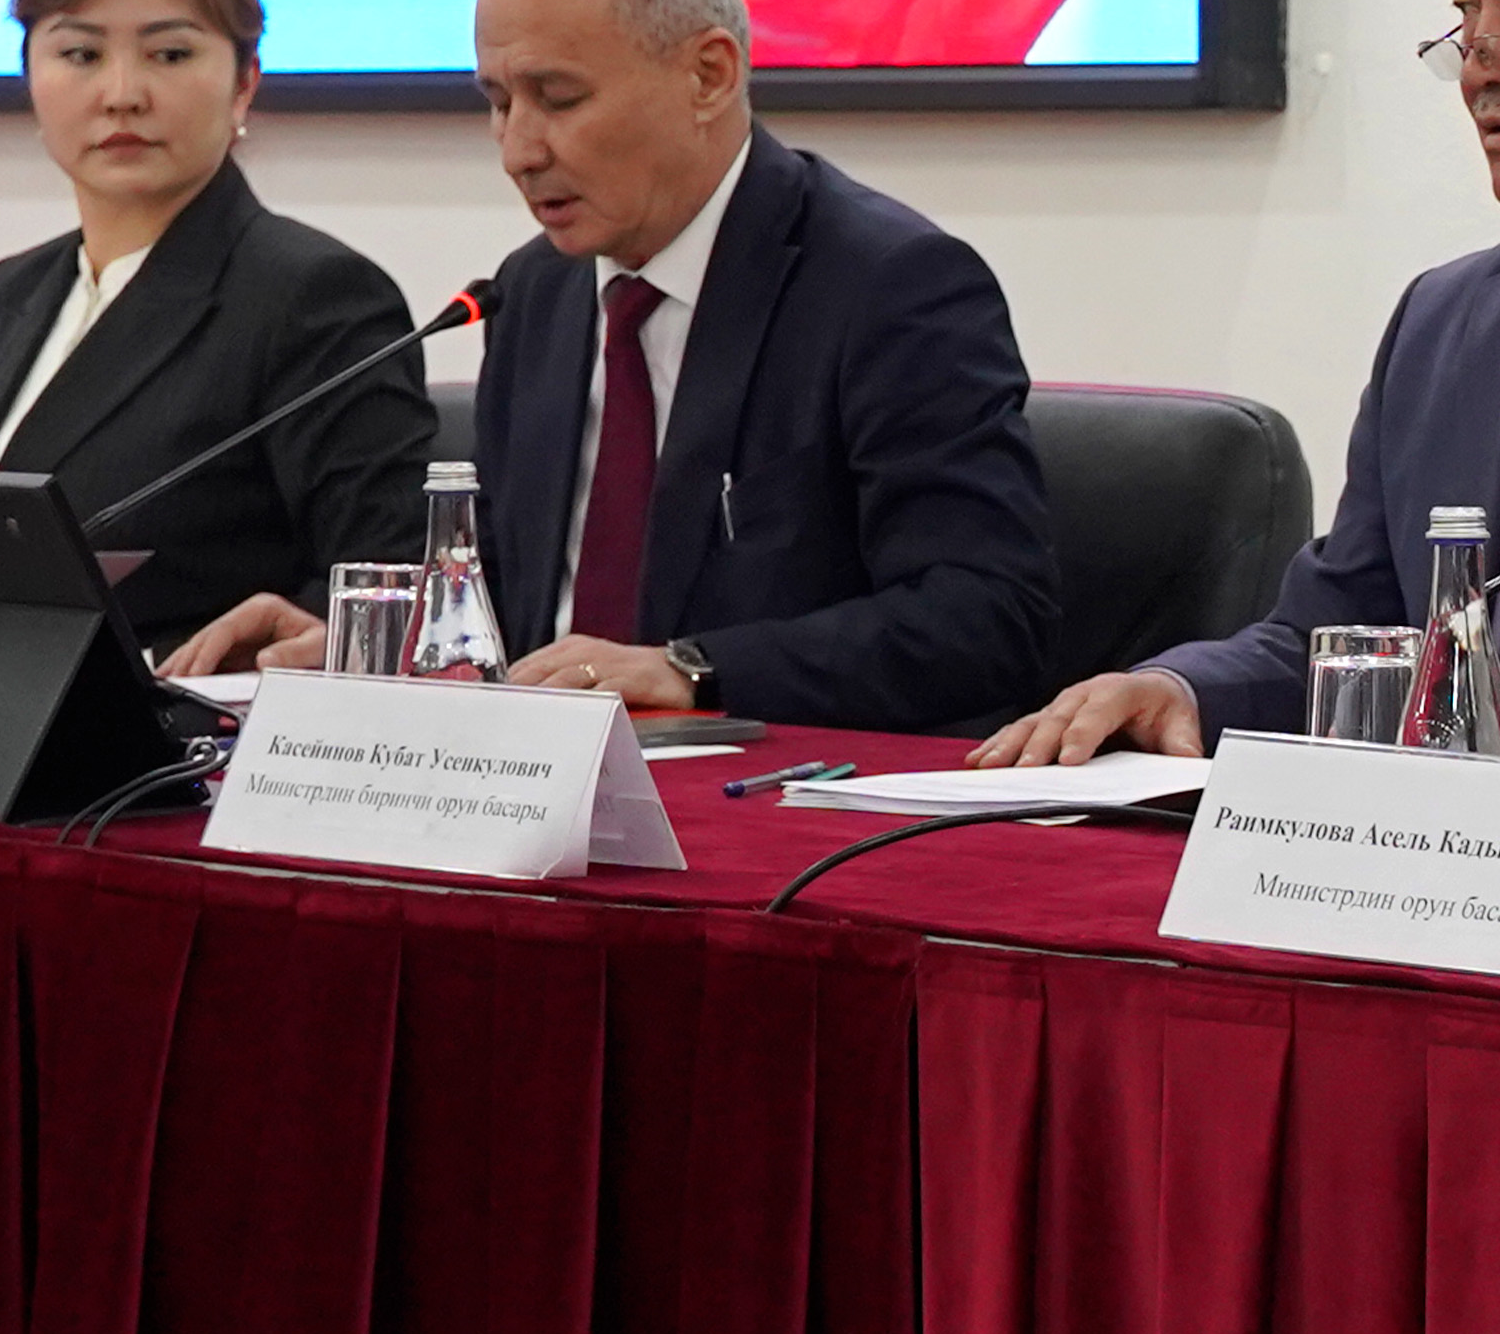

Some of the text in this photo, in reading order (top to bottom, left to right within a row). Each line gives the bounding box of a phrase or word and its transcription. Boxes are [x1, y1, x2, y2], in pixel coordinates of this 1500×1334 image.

[267, 735, 552, 779] Касейинов Кубат Усенкулович
[245, 772, 548, 823] Министрдин биринчи орун басары
[1214, 806, 1355, 844] Раимкулова
[1360, 823, 1431, 852] Асель
[1253, 873, 1396, 912] Министрдин
[1400, 897, 1456, 921] орун
